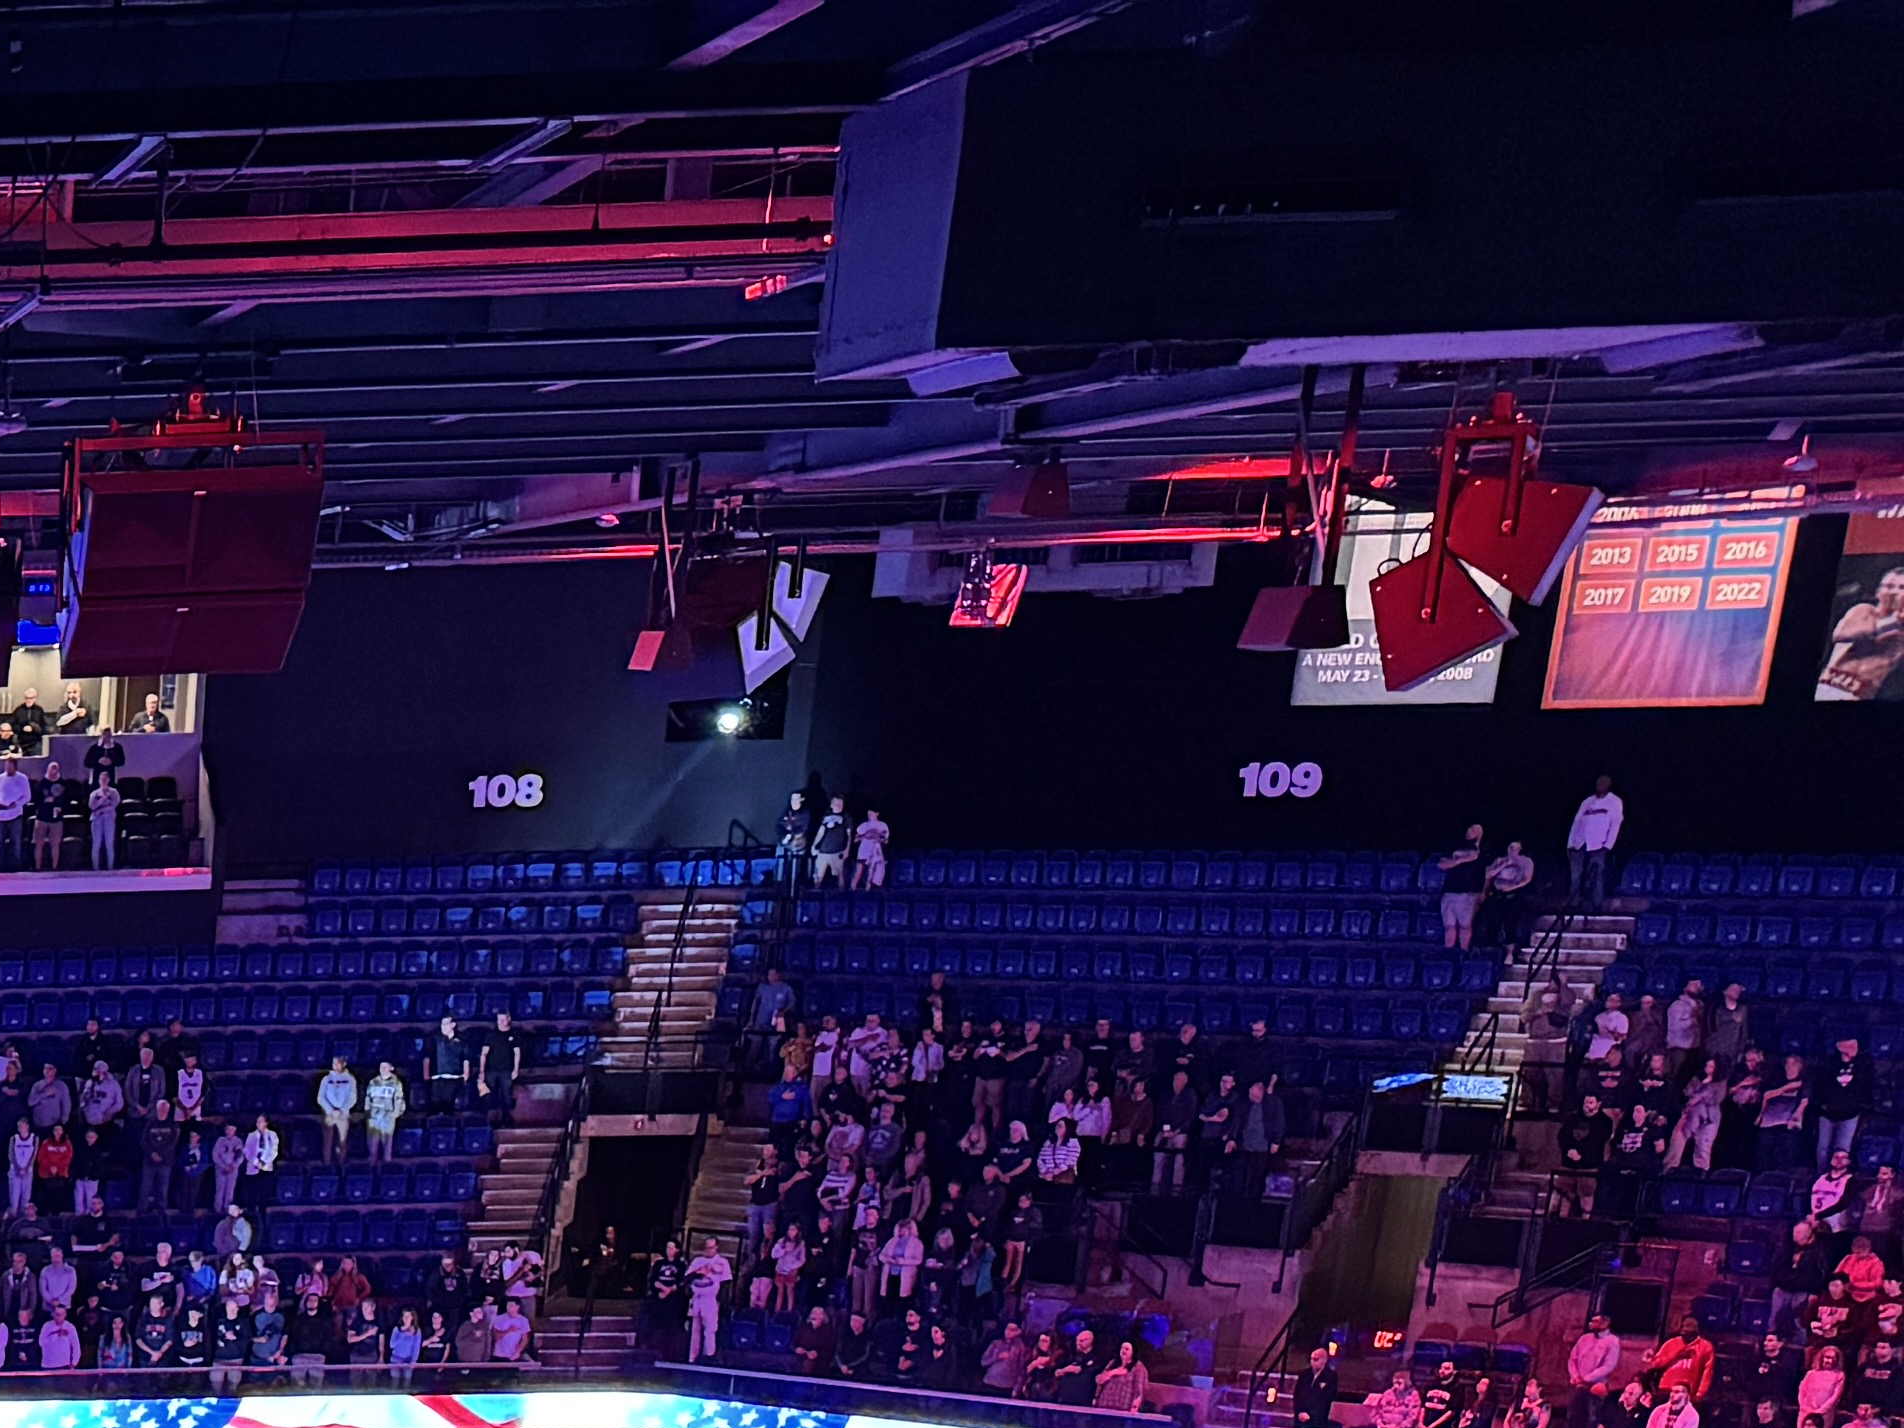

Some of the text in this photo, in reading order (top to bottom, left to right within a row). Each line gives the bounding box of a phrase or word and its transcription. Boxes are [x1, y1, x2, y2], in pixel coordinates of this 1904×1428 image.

[1590, 541, 1767, 566] 2013 2015 2016
[1583, 582, 1761, 605] 2017 2019 2022
[1316, 653, 1353, 666] NEW
[1318, 670, 1350, 683] MAY
[1352, 669, 1370, 682] 23
[469, 774, 544, 808] 108
[1239, 762, 1322, 798] 109
